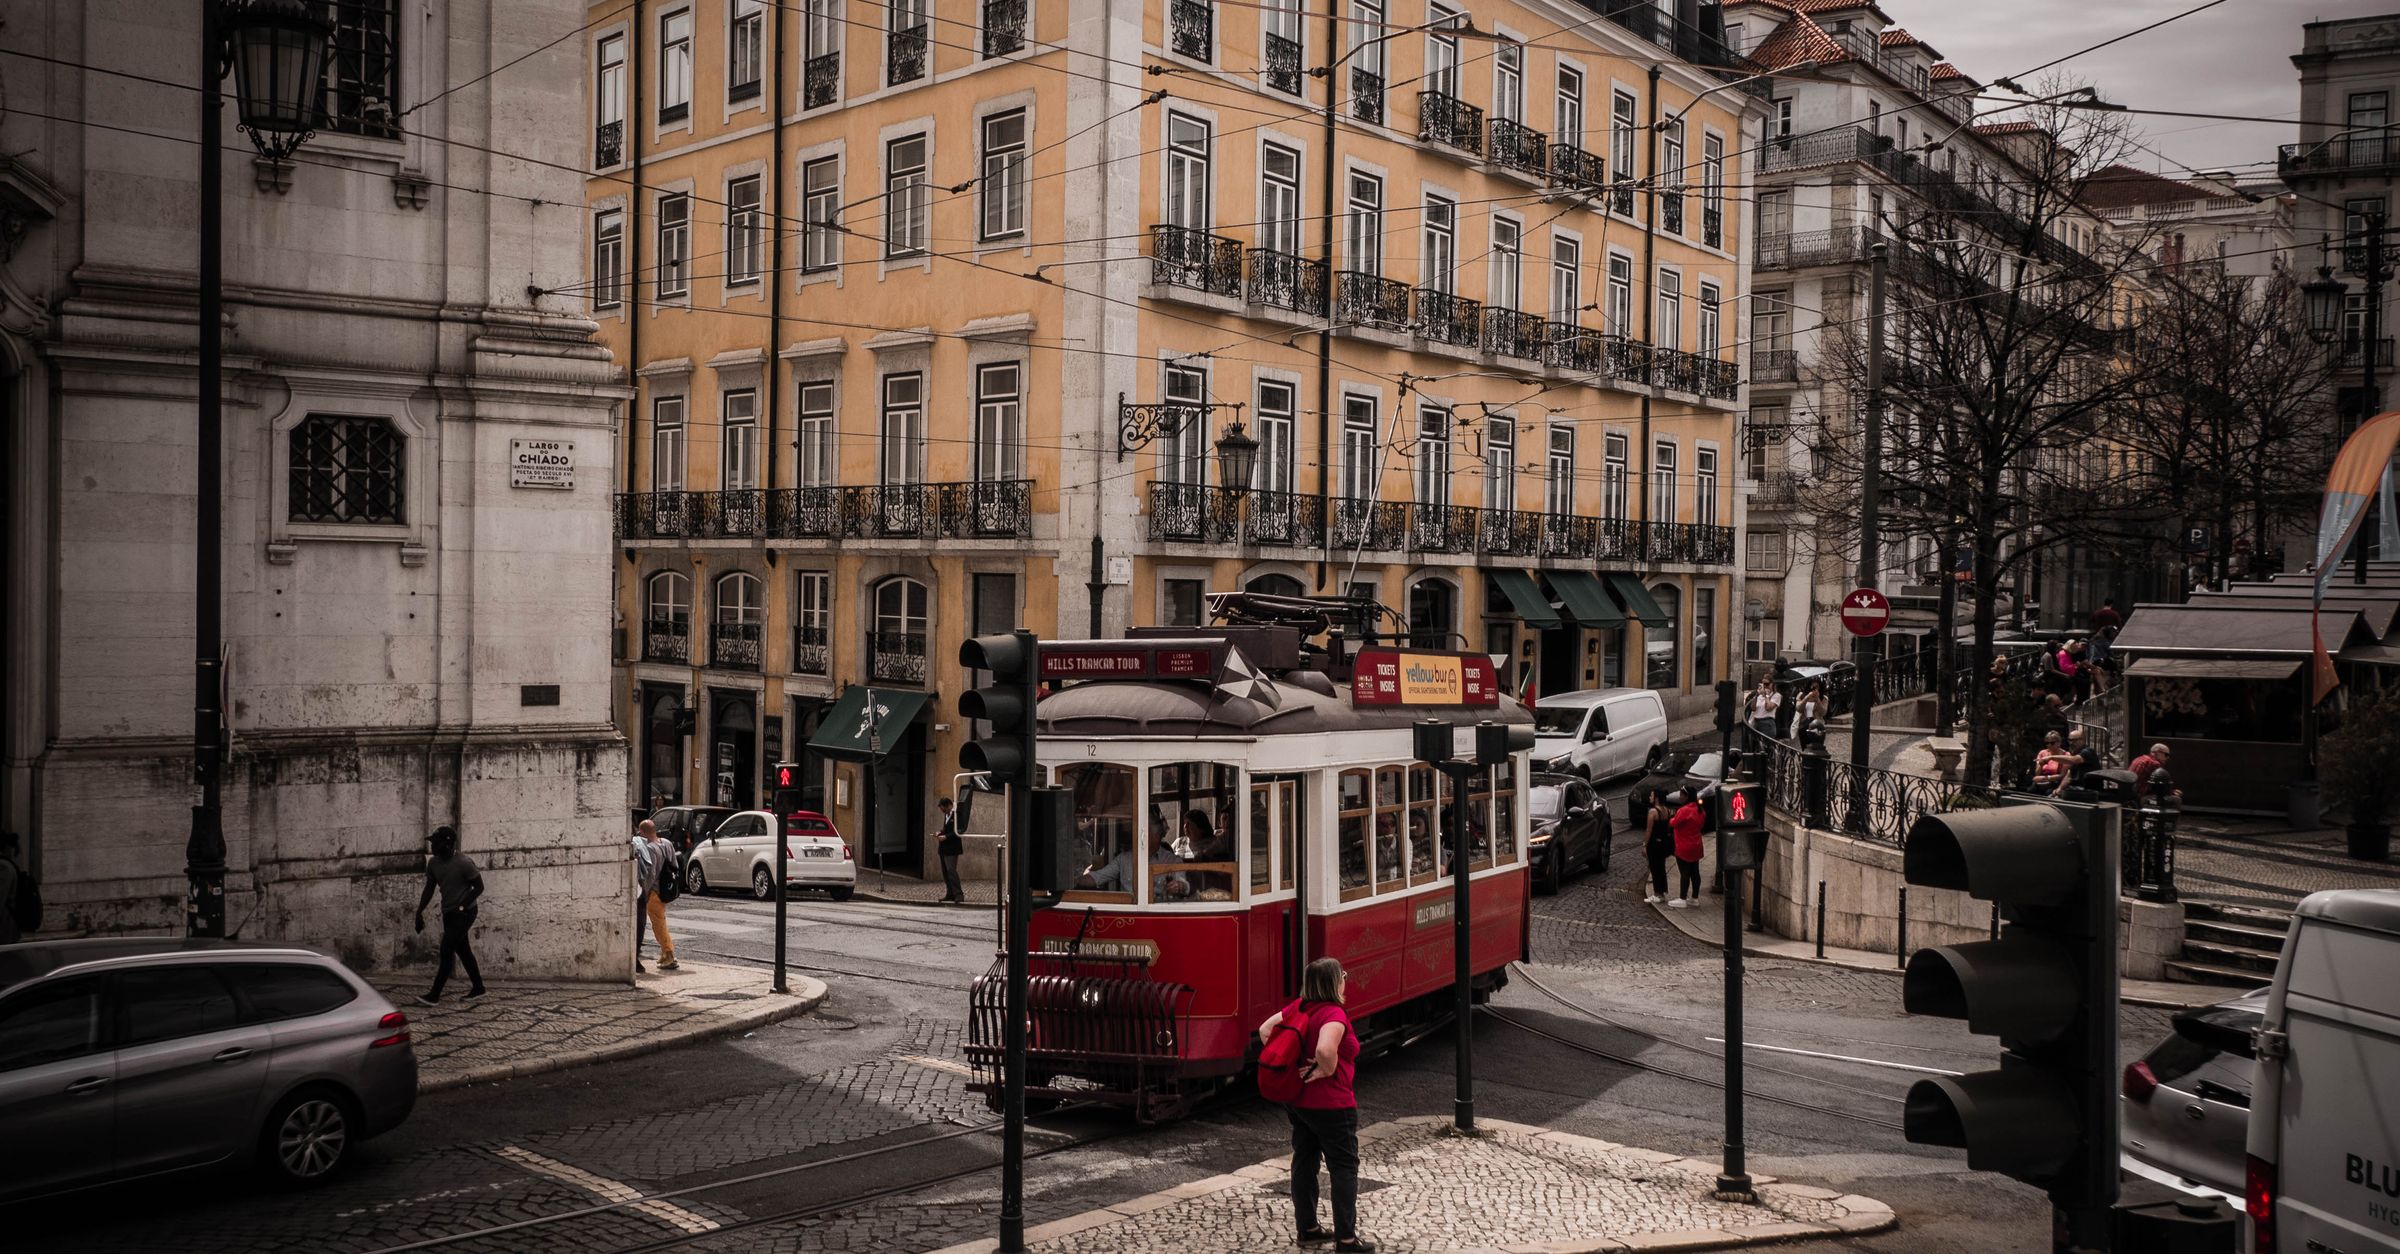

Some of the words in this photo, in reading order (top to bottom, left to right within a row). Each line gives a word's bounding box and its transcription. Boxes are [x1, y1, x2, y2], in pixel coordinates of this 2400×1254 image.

[529, 442, 559, 450] LARGO
[519, 454, 568, 465] CHIADO
[2191, 529, 2203, 544] P
[1048, 657, 1074, 670] HILLS
[1076, 657, 1115, 670] TRAMCAR
[1117, 657, 1140, 670] TOUR
[1377, 664, 1396, 676] TICKETS
[1465, 668, 1480, 679] TICKETS
[1379, 681, 1395, 693] INSIDE
[1467, 683, 1480, 694] INSIDE
[1087, 744, 1097, 757] 12
[1416, 907, 1429, 924] HILLS
[1044, 940, 1070, 953] HILLS
[1121, 944, 1152, 958] TOUR
[2346, 1152, 2400, 1198] BLU
[2368, 1201, 2400, 1226] HYG
